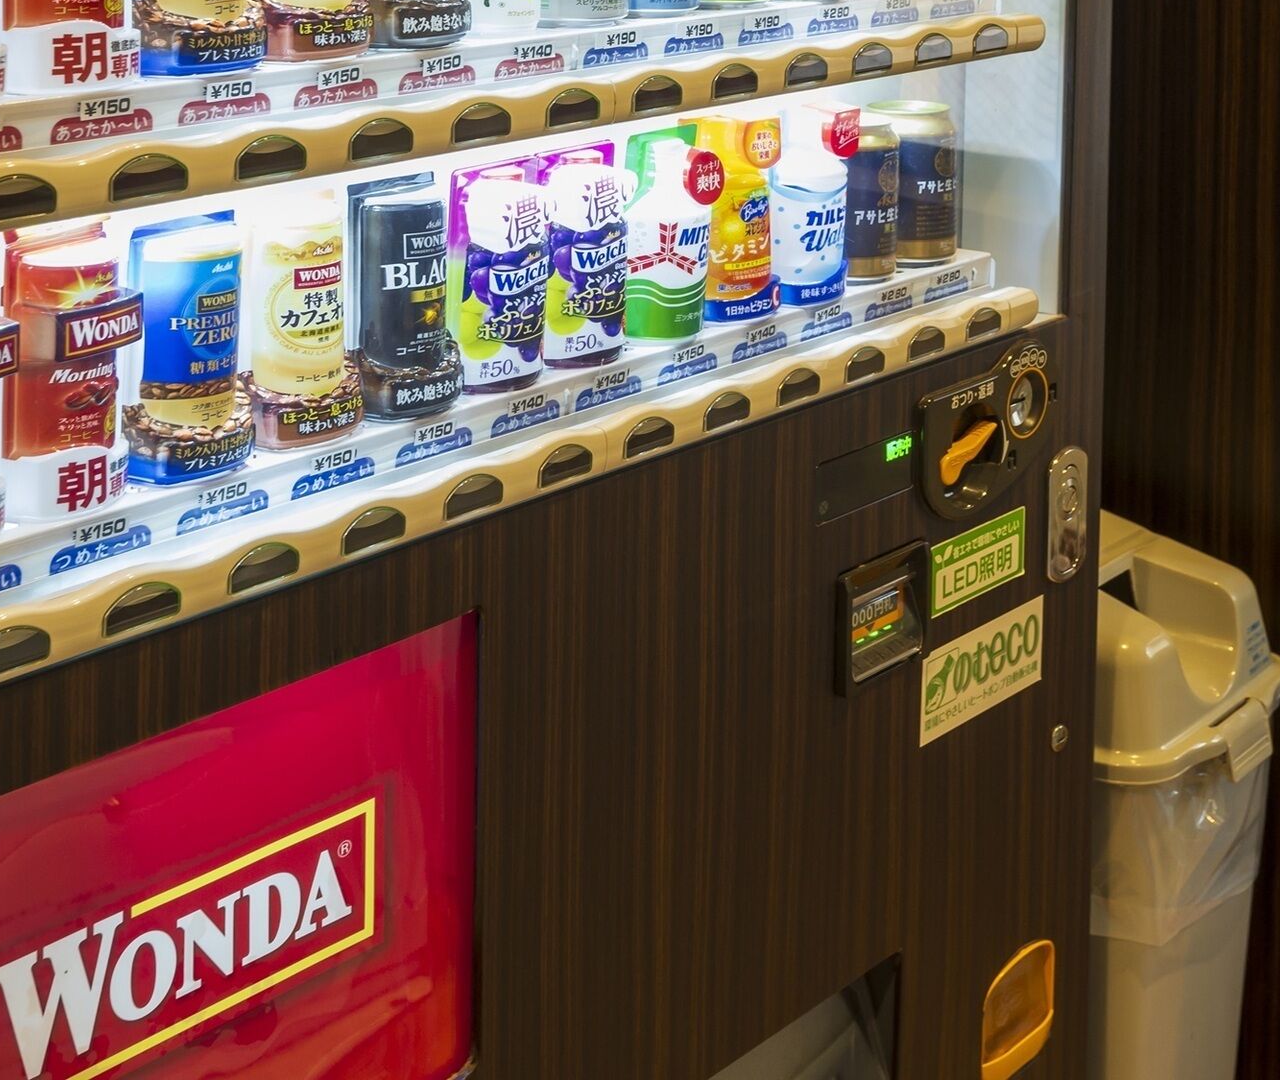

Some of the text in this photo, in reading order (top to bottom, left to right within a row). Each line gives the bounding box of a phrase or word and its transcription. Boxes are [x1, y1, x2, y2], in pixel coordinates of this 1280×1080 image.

[55, 6, 98, 15] コーヒー
[215, 4, 240, 14] コーヒー
[823, 6, 849, 19] ¥280
[686, 23, 713, 37] ¥190
[755, 15, 780, 29] ¥190
[314, 31, 368, 47] 味わい深さ
[606, 30, 636, 46] ¥190
[52, 31, 107, 84] 朝
[521, 44, 553, 59] ¥140
[111, 51, 140, 78] 専用
[426, 54, 462, 73] ¥150
[322, 68, 360, 86] ¥150
[211, 80, 253, 99] ¥150
[84, 98, 131, 117] ¥150
[696, 160, 720, 174] スッキリ
[696, 174, 721, 192] 爽快
[576, 242, 626, 269] Welch
[710, 233, 770, 263] ビタミン
[299, 264, 341, 281] WONDA
[493, 259, 547, 292] Welch
[936, 270, 961, 284] ¥280
[304, 289, 338, 309] 特製
[881, 287, 907, 301] ¥280
[816, 305, 841, 321] ¥140
[70, 311, 139, 348] WONDA
[750, 325, 776, 342] ¥140
[677, 345, 705, 363] ¥150
[48, 362, 114, 384] Morning
[596, 373, 625, 390] ¥140
[511, 394, 543, 414] ¥140
[951, 382, 995, 409] おつり・返却
[202, 409, 228, 421] コーヒー
[283, 397, 363, 424] ほっと一息つける
[299, 412, 355, 435] 味わい深さ
[417, 422, 453, 441] ¥150
[59, 431, 99, 442] コーヒー
[885, 436, 913, 462] 販売中
[314, 450, 352, 471] ¥150
[57, 456, 107, 512] 朝
[206, 481, 247, 506] ¥150
[80, 518, 126, 543] ¥150
[943, 543, 1012, 599] LED照明
[953, 614, 1039, 695] のむeco
